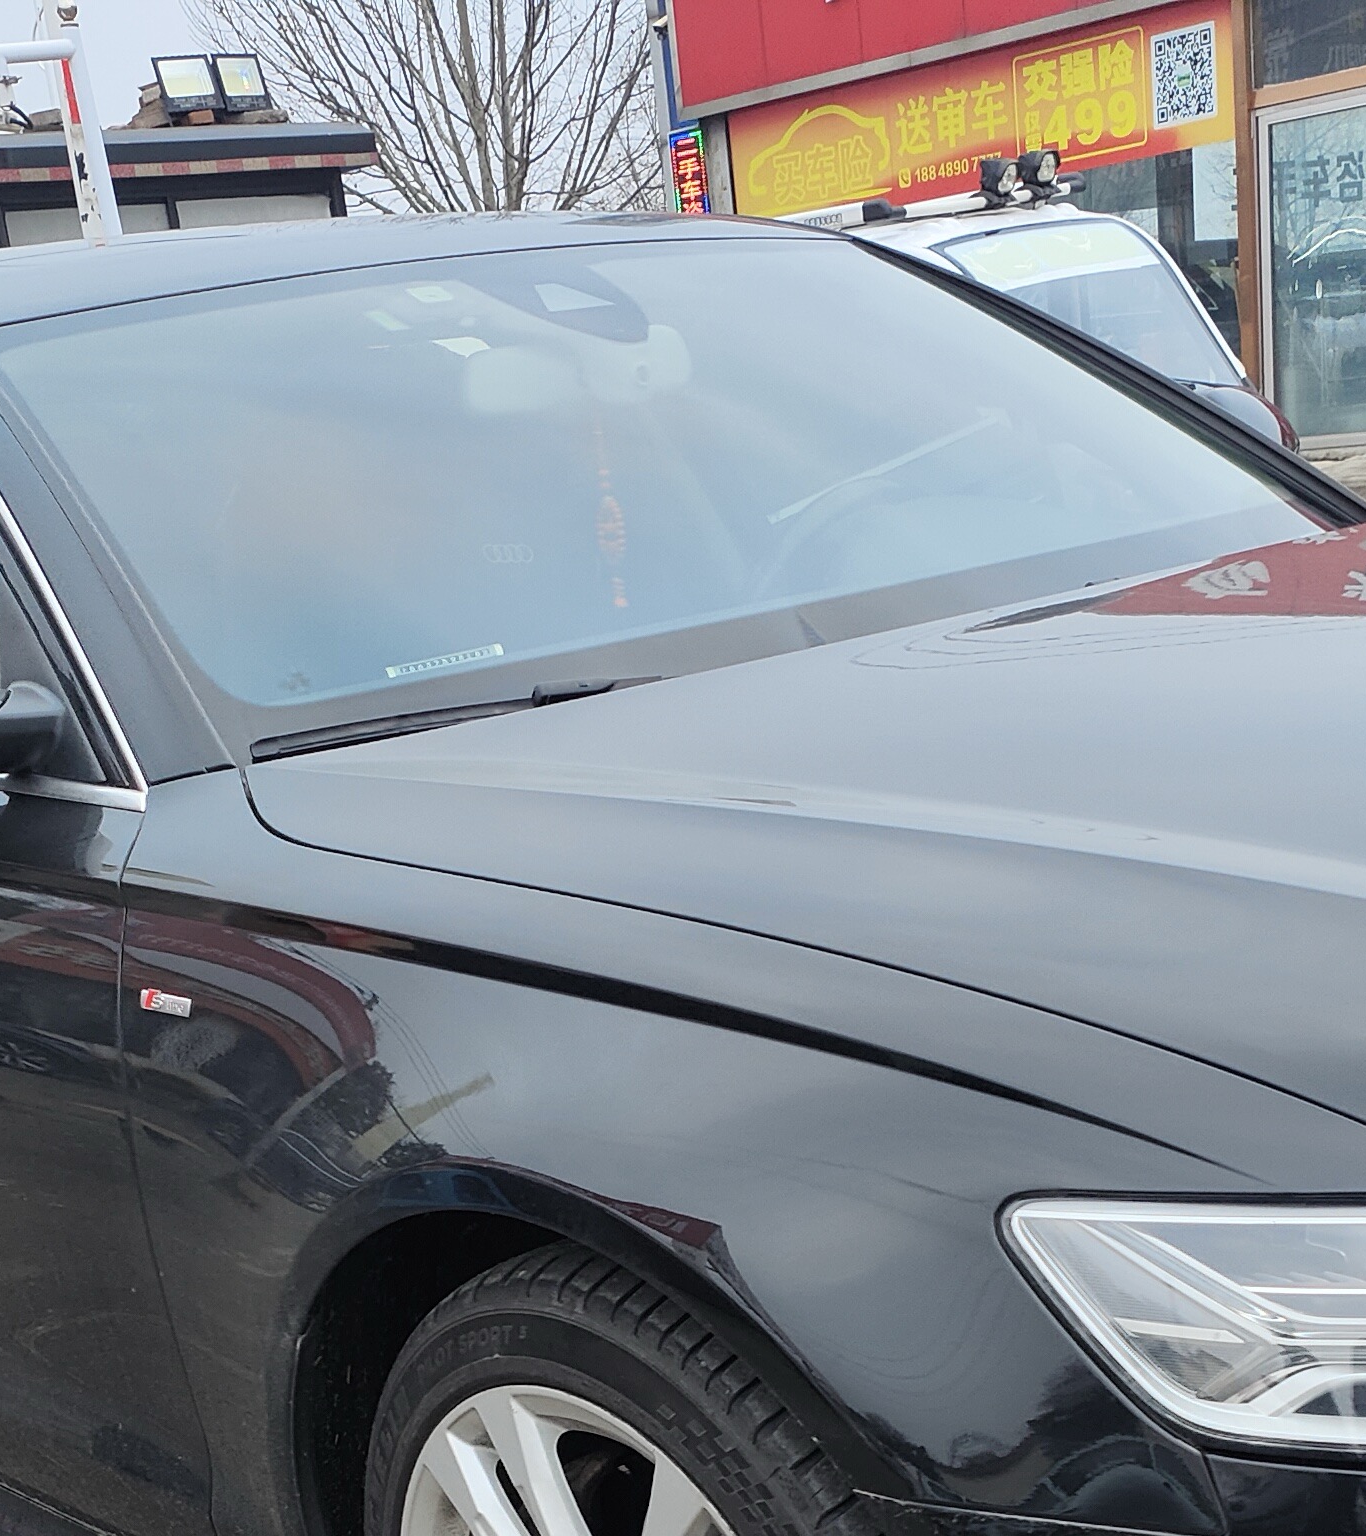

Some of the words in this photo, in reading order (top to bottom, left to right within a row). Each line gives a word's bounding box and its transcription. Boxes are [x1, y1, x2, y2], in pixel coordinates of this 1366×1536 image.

[1023, 39, 1135, 107] 交强险
[895, 80, 1008, 156] 送审车
[1044, 90, 1137, 151] 499
[773, 134, 875, 205] 买车险
[458, 1324, 512, 1353] SPORT
